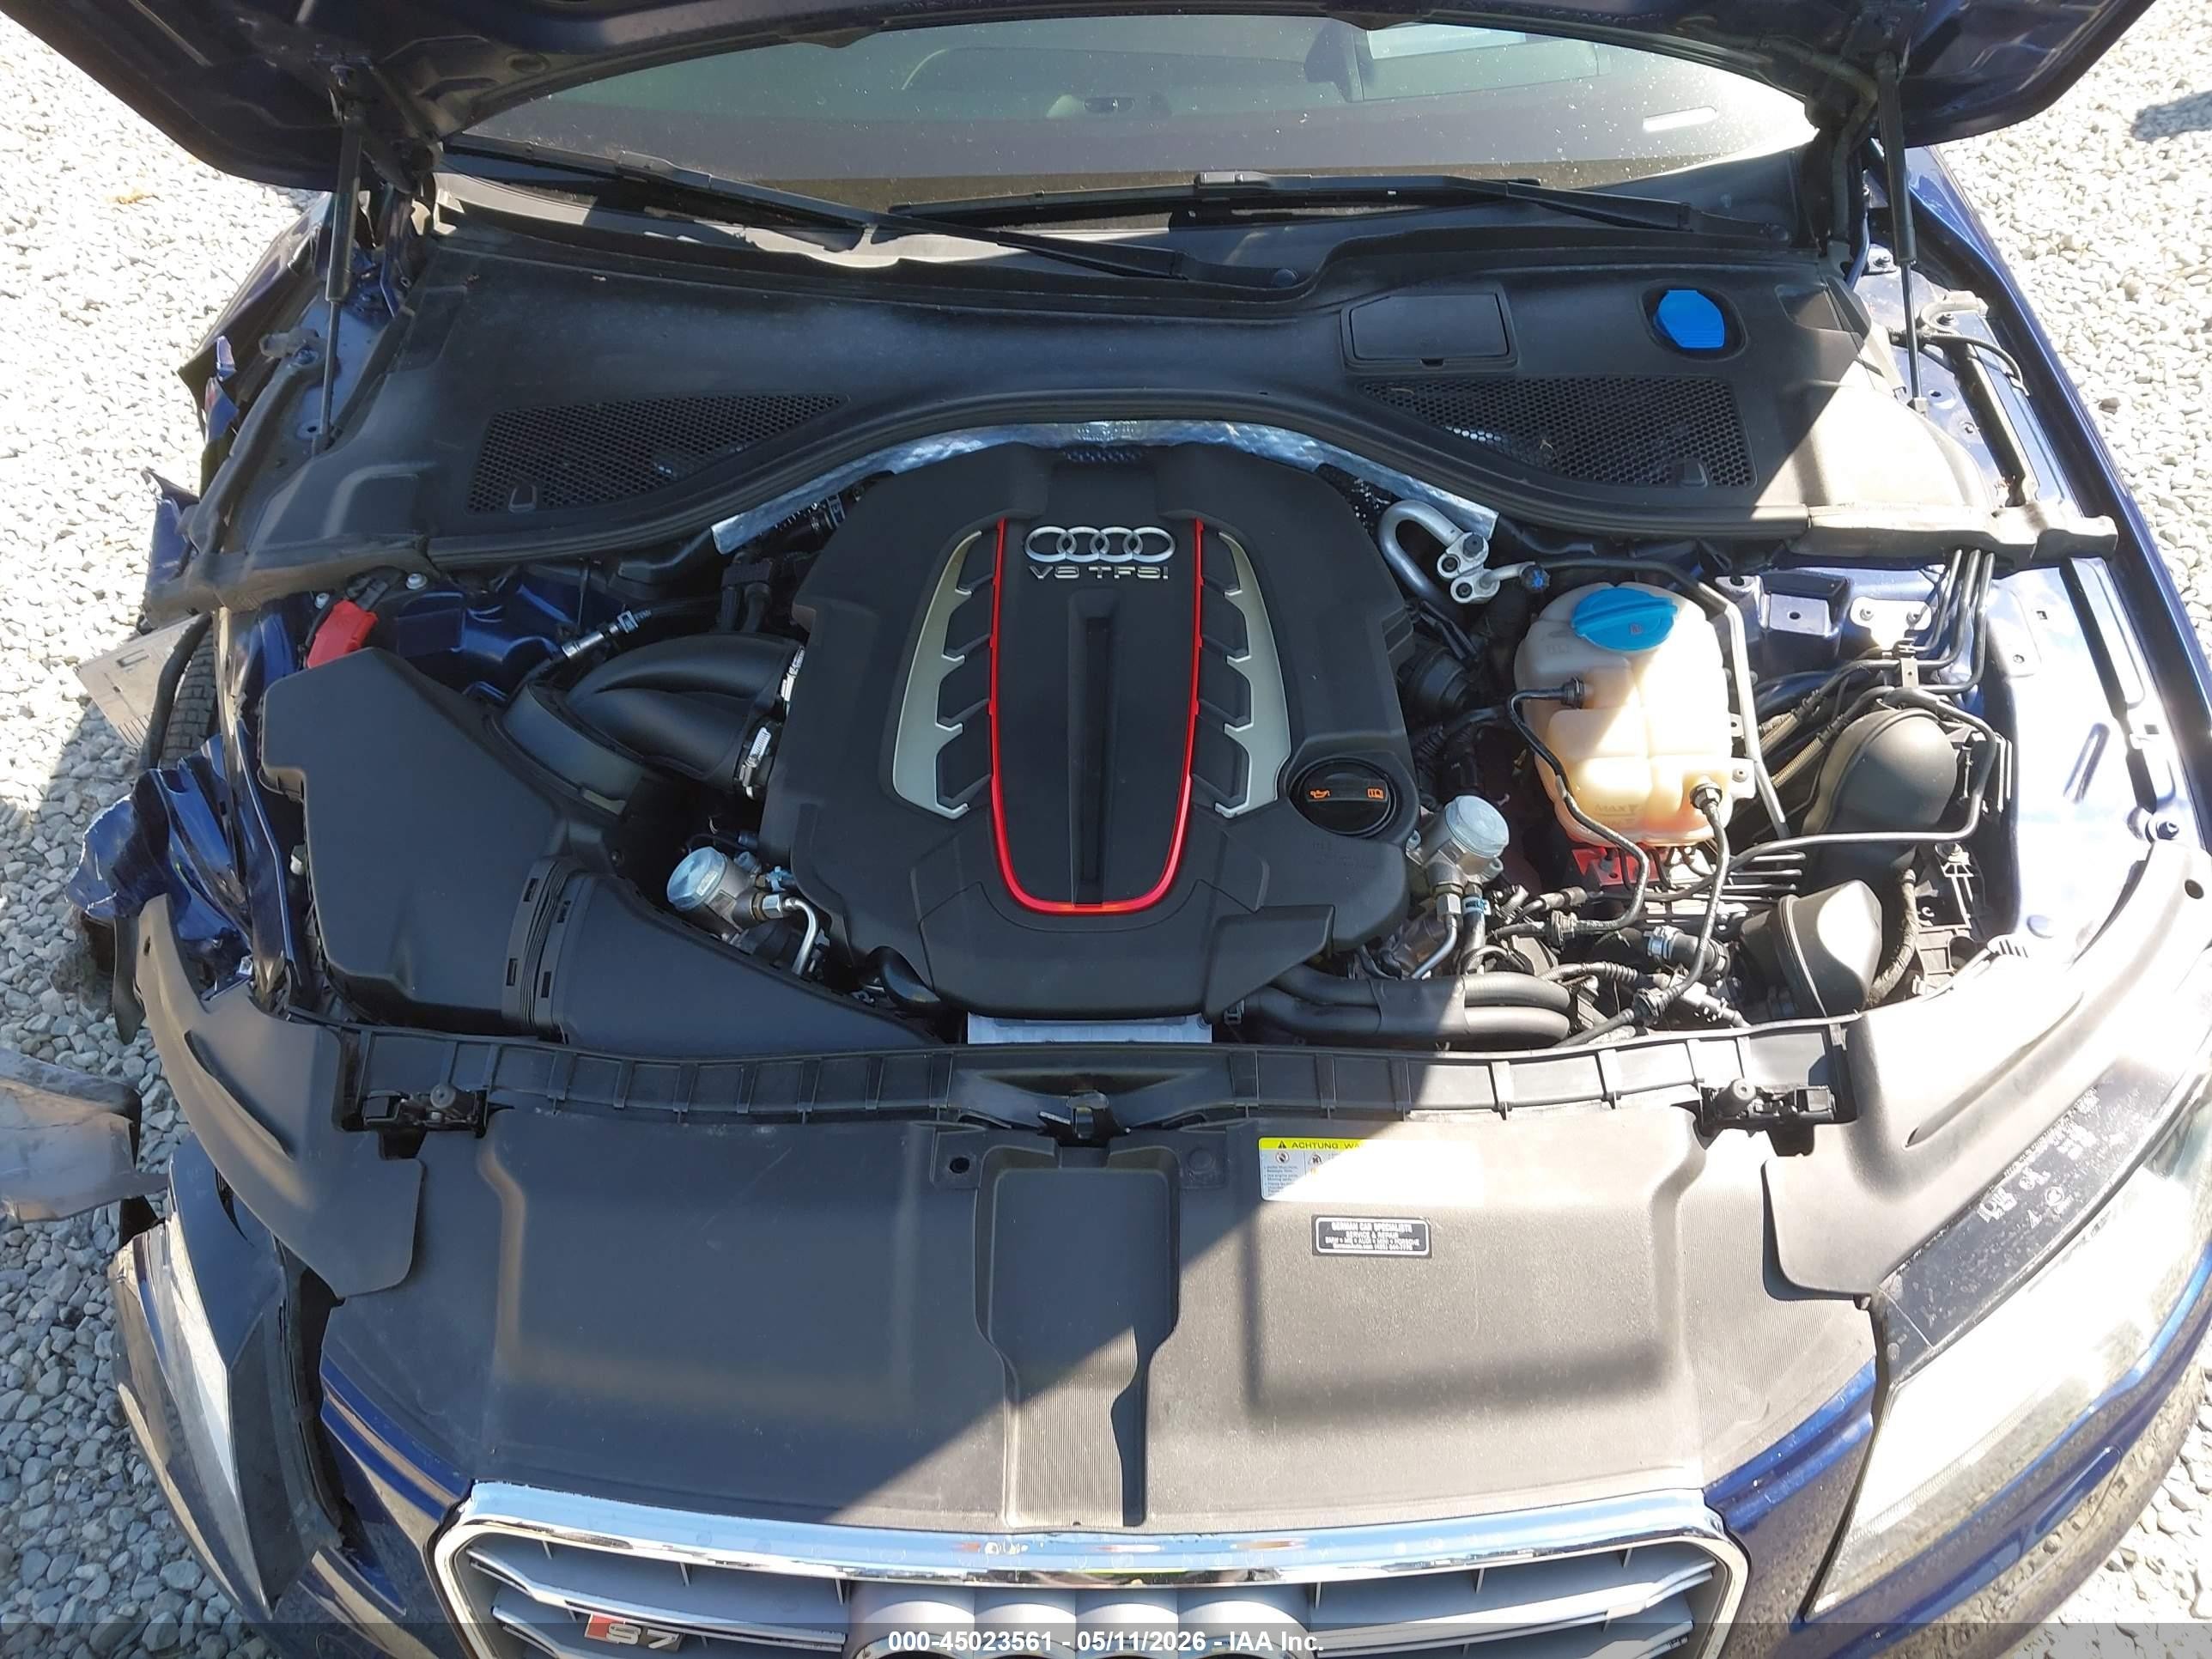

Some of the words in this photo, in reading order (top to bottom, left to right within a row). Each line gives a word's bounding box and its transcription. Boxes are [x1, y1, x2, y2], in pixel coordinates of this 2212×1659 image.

[1030, 566, 1079, 580] V8
[1088, 566, 1169, 580] TFSI
[1359, 1222, 1372, 1231] CAR
[605, 1622, 679, 1650] S7
